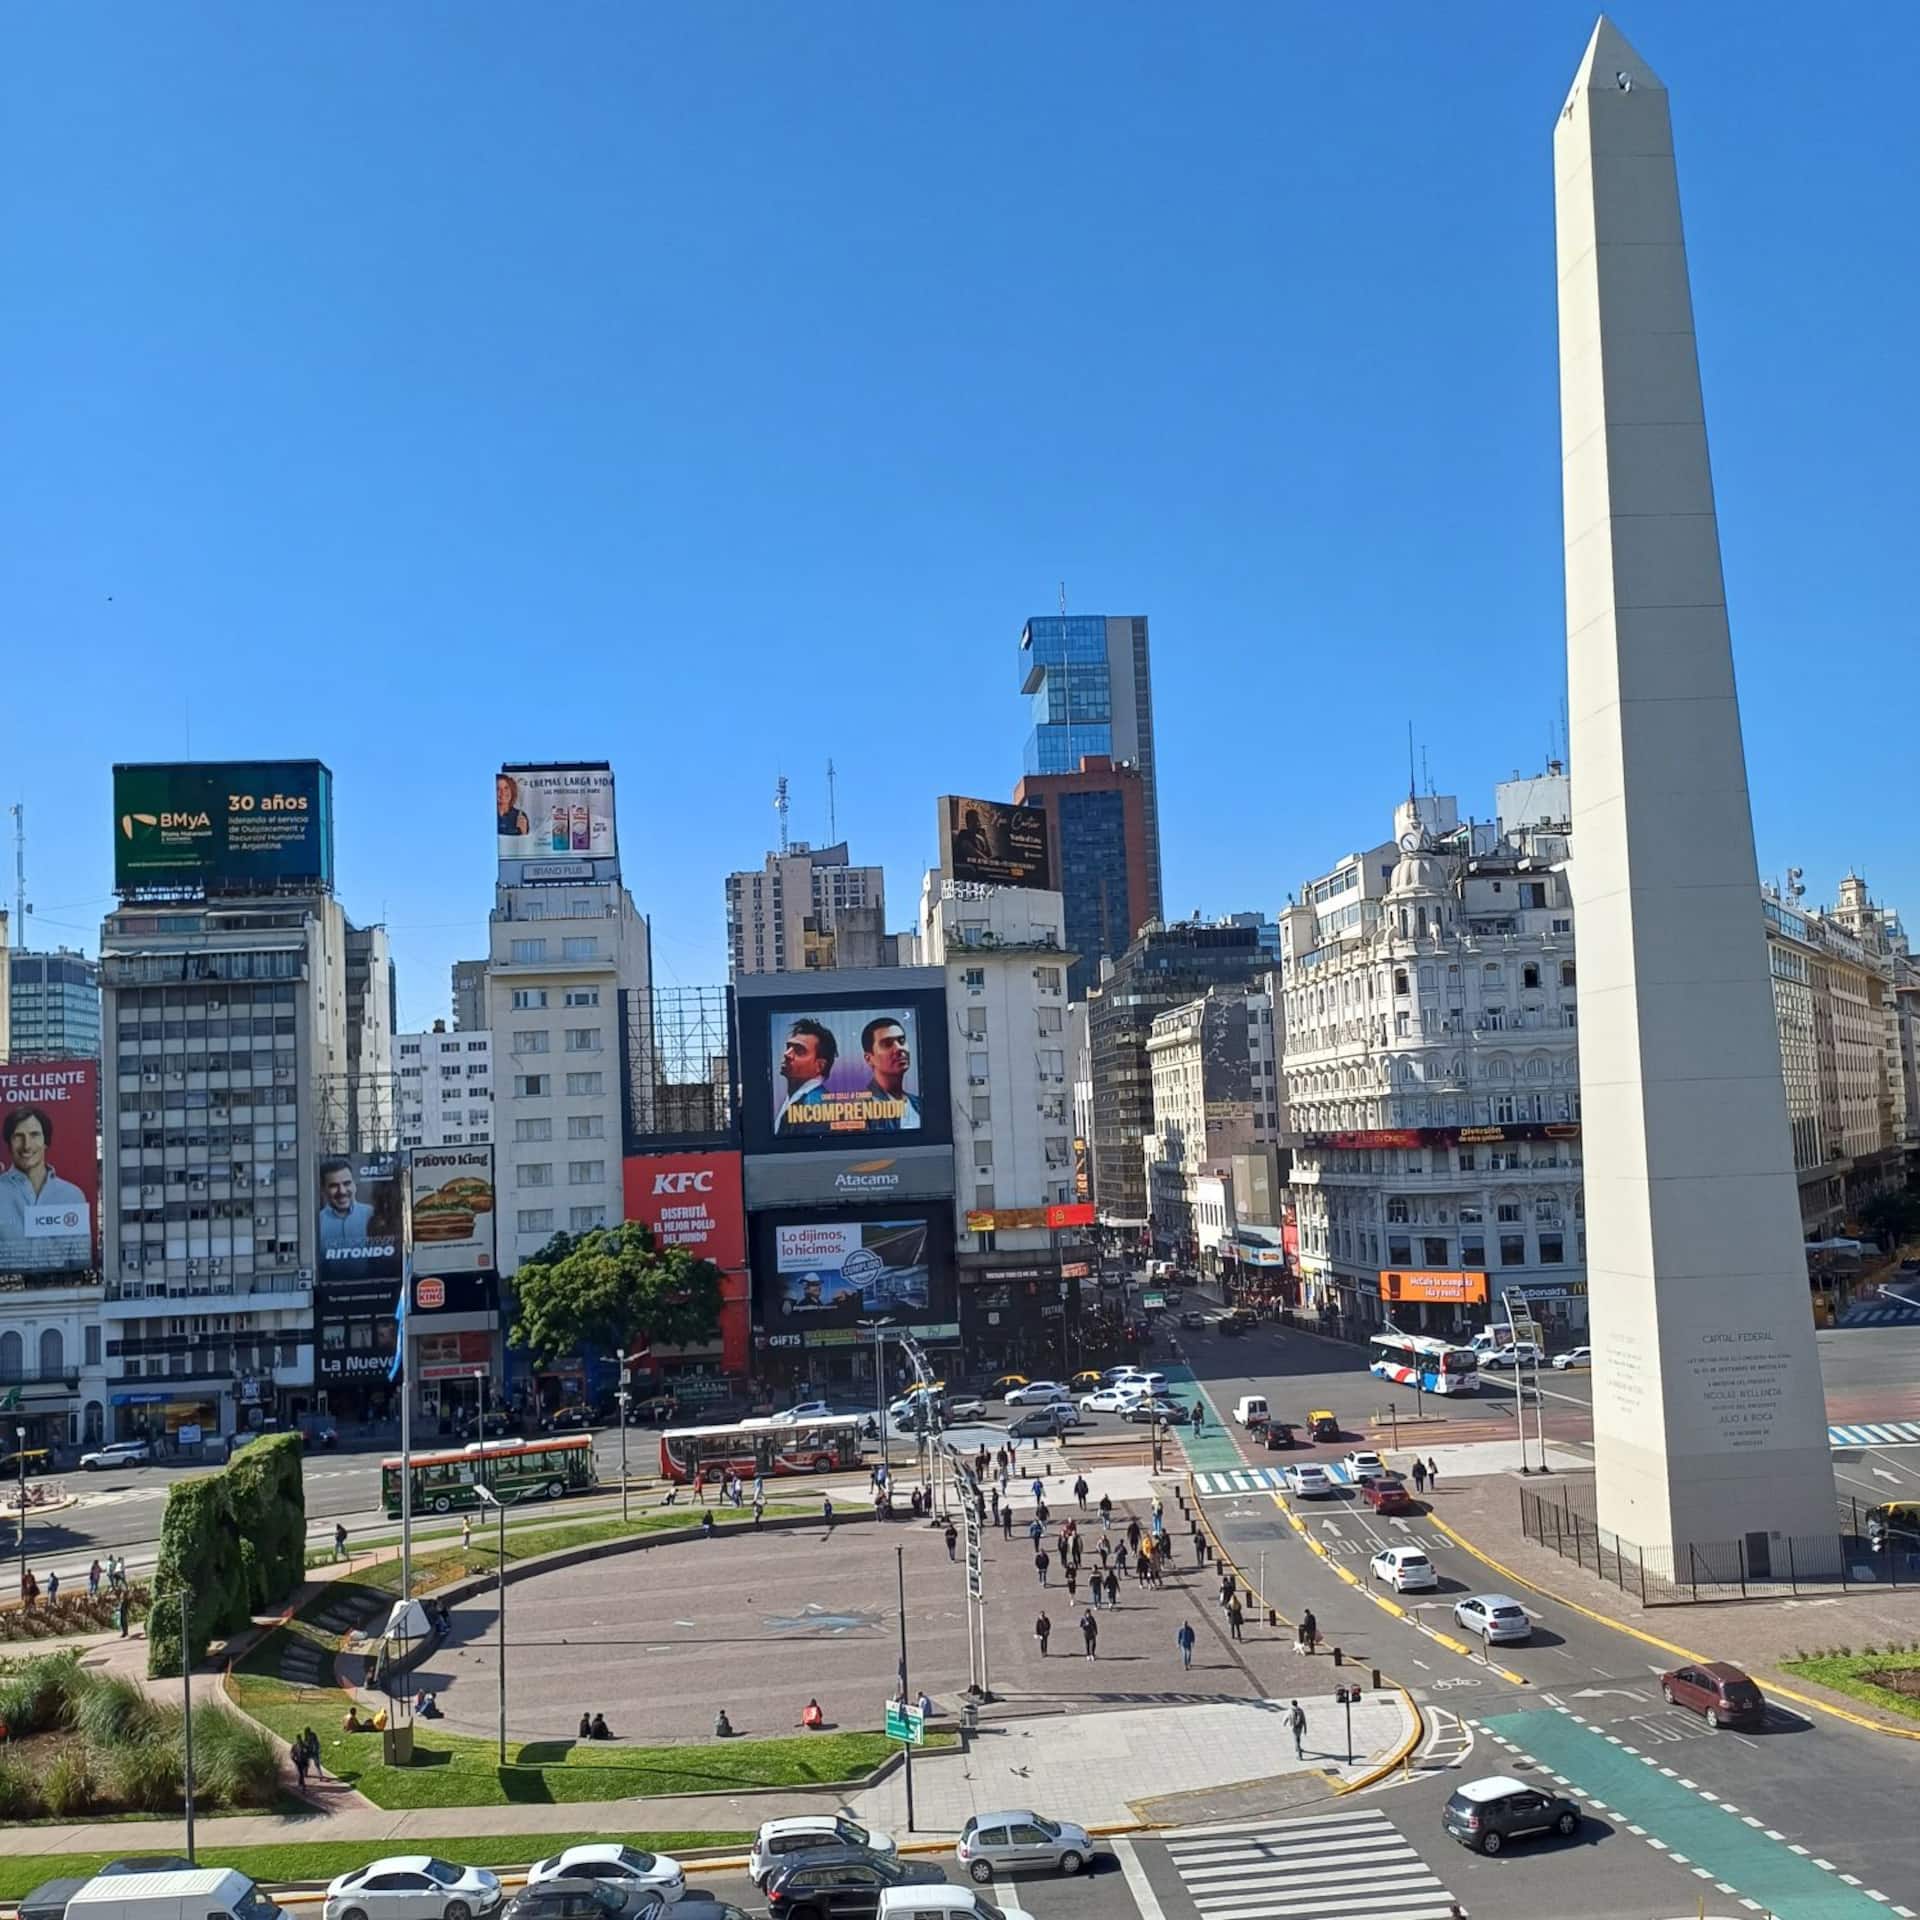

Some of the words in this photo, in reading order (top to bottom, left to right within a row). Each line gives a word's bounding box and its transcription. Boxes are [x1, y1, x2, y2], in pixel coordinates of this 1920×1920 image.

[564, 776, 592, 786] LARGA
[228, 795, 255, 811] 30
[261, 794, 308, 811] años
[160, 812, 211, 830] BMyA
[22, 1071, 85, 1087] CLIENTE
[6, 1088, 71, 1103] ONLINE.
[458, 1153, 488, 1167] King
[652, 1170, 714, 1195] KFC
[834, 1173, 899, 1187] Atacama
[35, 1215, 61, 1225] ICBC
[654, 1222, 663, 1233] EL
[664, 1220, 690, 1232] MEJOR
[691, 1219, 716, 1230] POLLO
[782, 1231, 797, 1243] Lo
[799, 1229, 846, 1244] dijimos,
[325, 1246, 395, 1260] RITONDO
[782, 1243, 794, 1257] lo
[795, 1242, 845, 1256] hicimos.
[419, 1292, 444, 1301] KING
[769, 1334, 801, 1347] GIFTS
[321, 1358, 341, 1372] La
